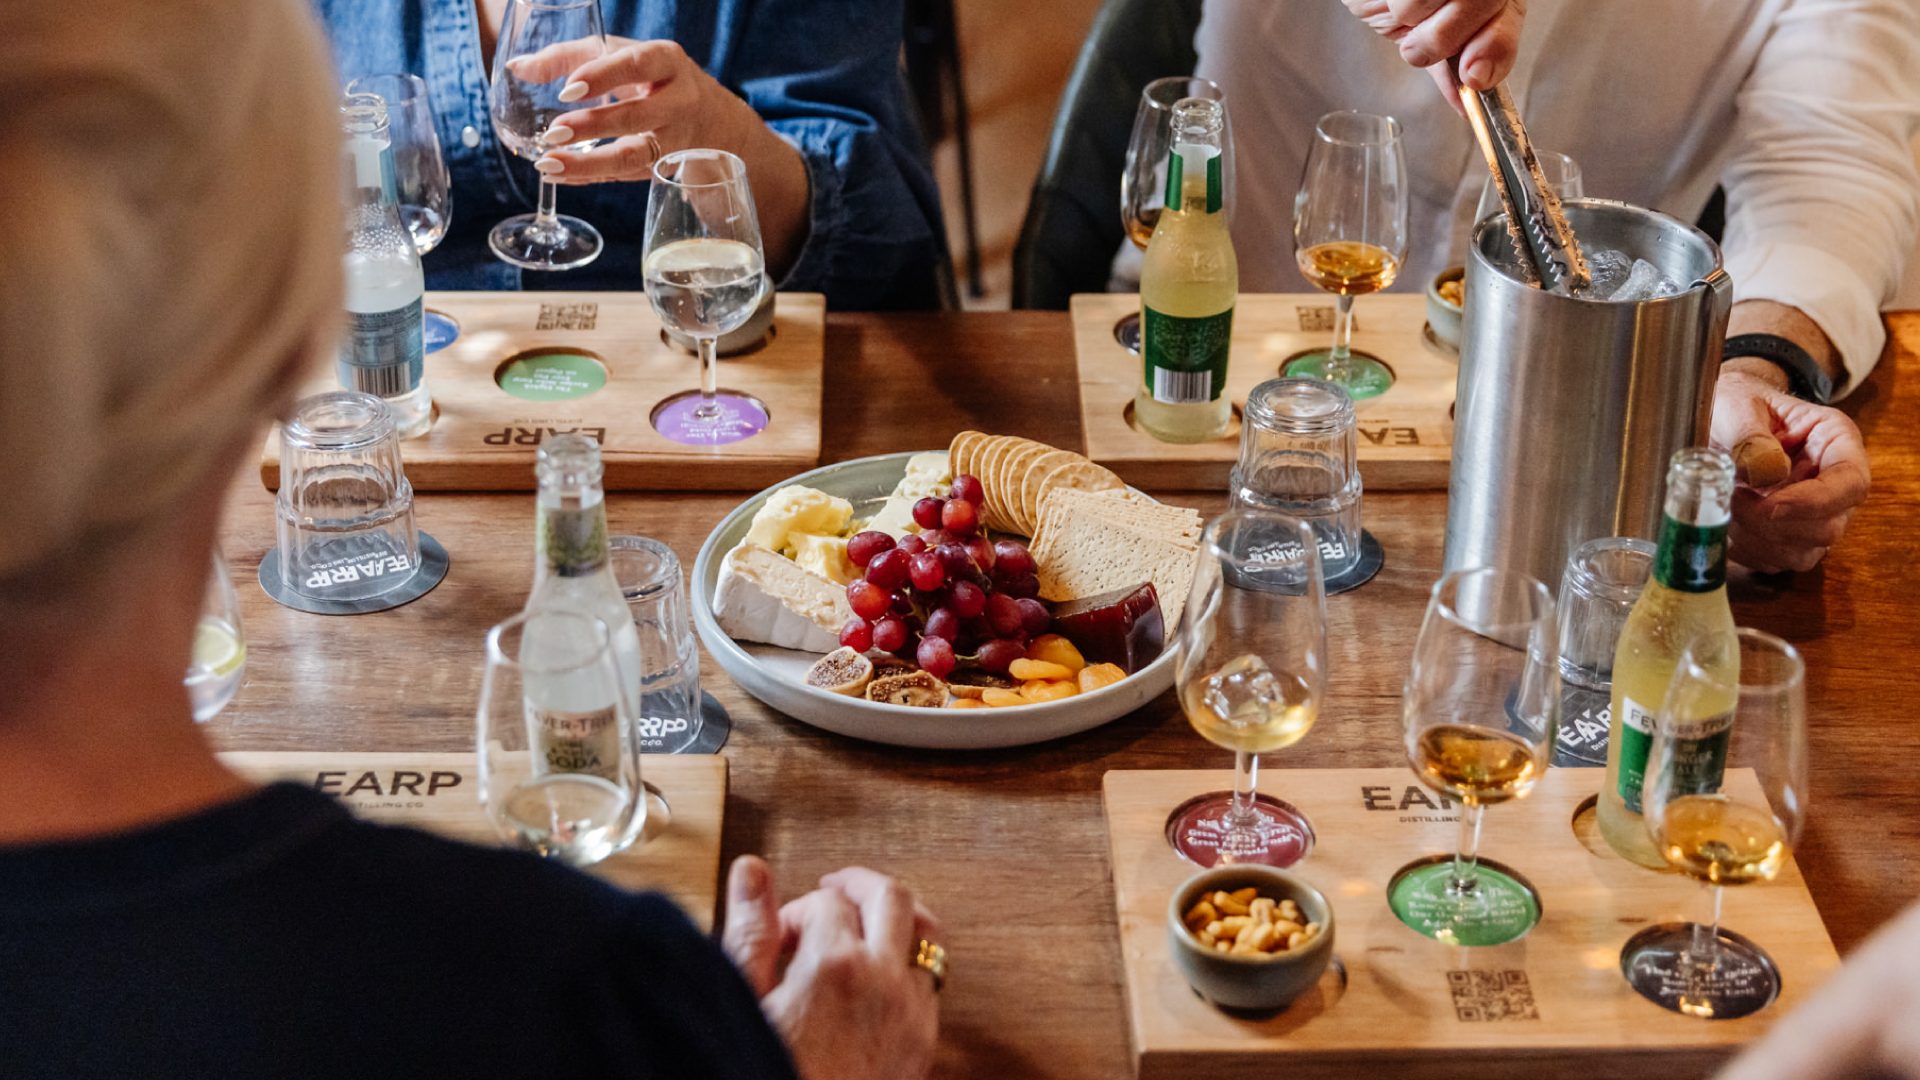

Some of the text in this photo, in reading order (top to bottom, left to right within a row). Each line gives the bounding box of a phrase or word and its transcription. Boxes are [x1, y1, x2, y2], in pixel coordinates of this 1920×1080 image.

[1357, 427, 1420, 445] EA
[314, 771, 463, 797] EARP
[1361, 785, 1454, 811] EA
